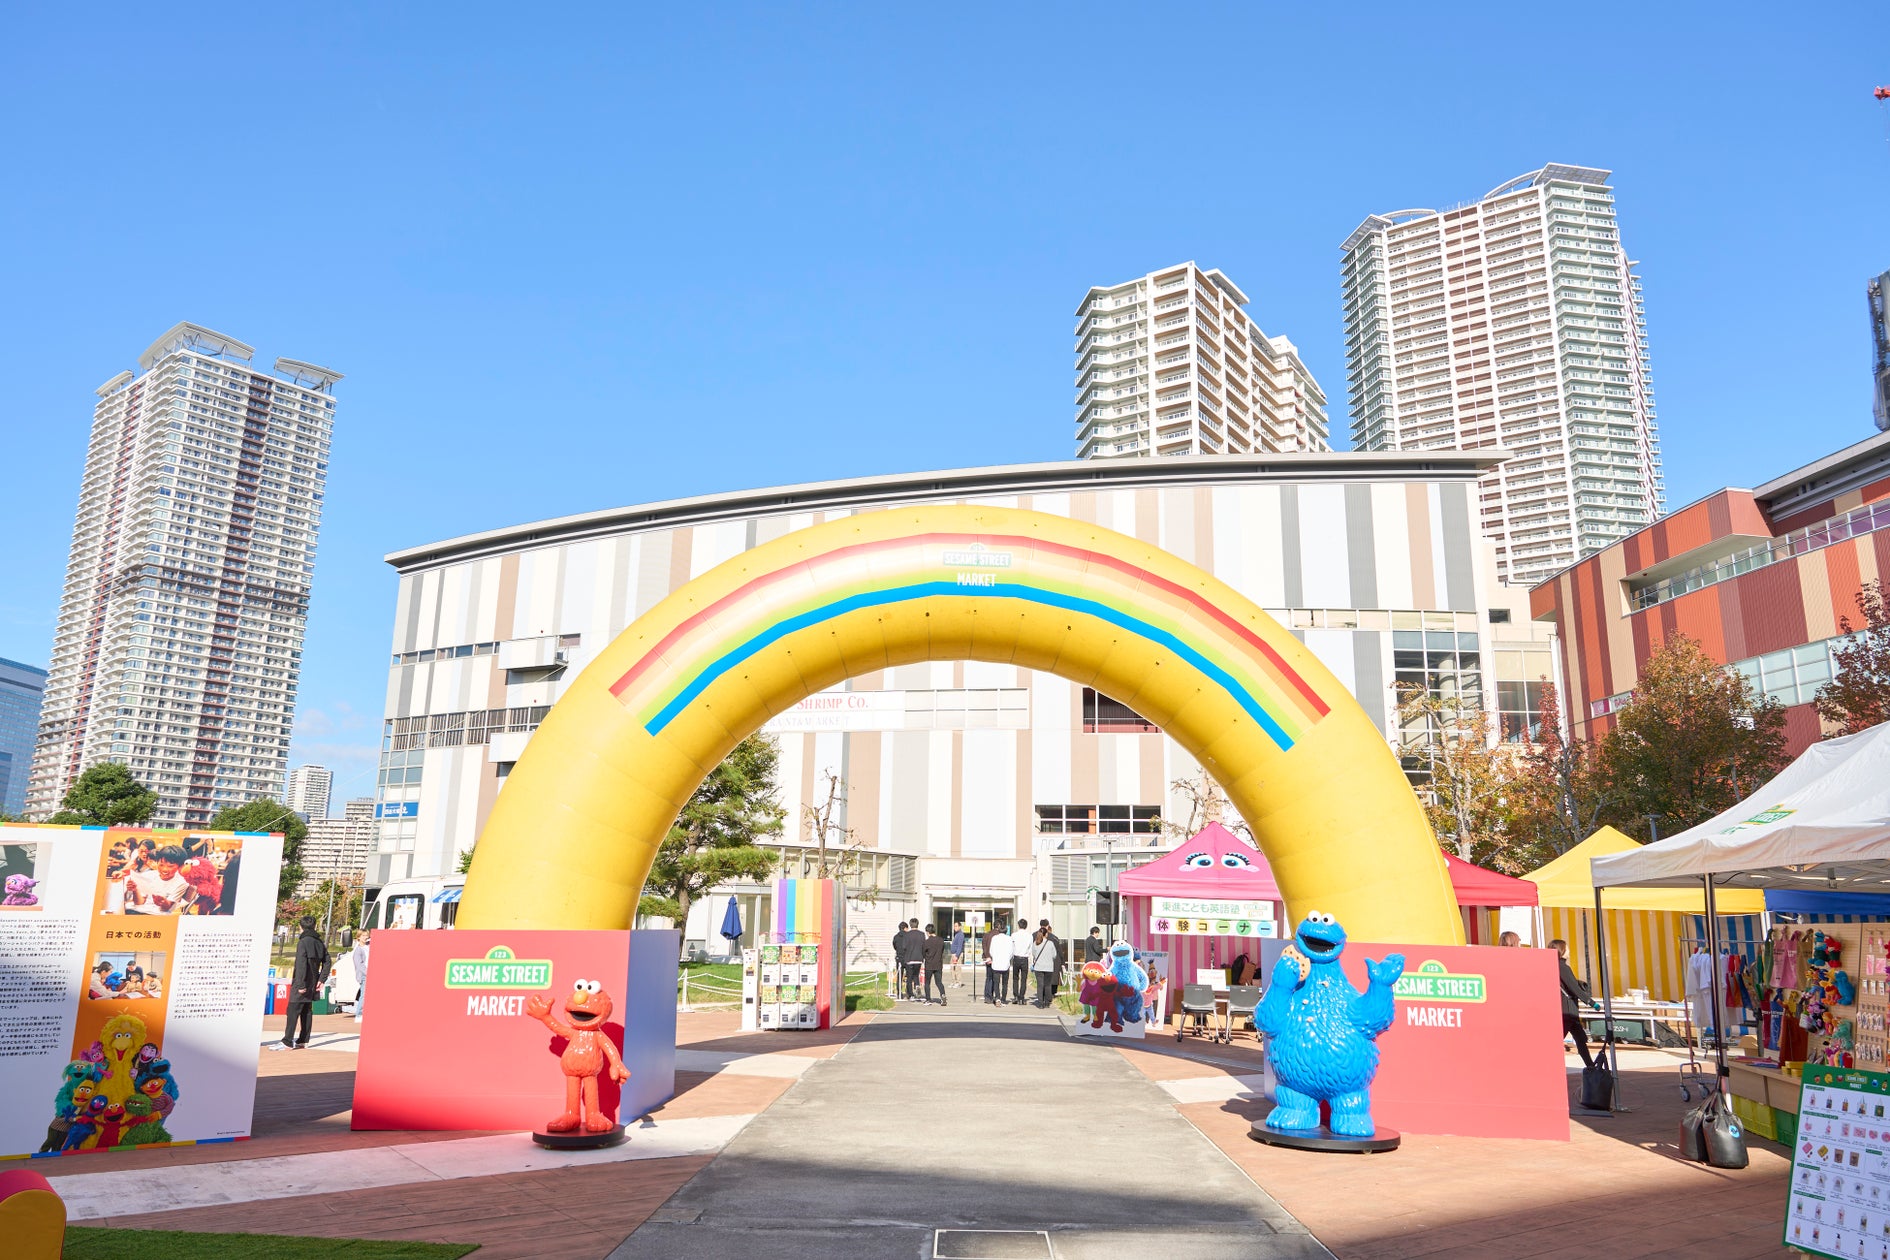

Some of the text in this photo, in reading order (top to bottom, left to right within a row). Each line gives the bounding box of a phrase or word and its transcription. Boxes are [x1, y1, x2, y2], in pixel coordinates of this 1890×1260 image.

[957, 572, 996, 587] MARKET
[796, 697, 843, 710] SHRIMP
[1162, 901, 1240, 915] 東進こども英語塾
[1157, 919, 1271, 933] 体験コーナー
[105, 930, 162, 939] 日本での活動
[494, 951, 507, 959] 123
[451, 964, 547, 983] SESAME STREET
[1392, 977, 1480, 997] ESAME STREET
[466, 995, 526, 1016] MARKET
[1406, 1006, 1463, 1028] MARKET
